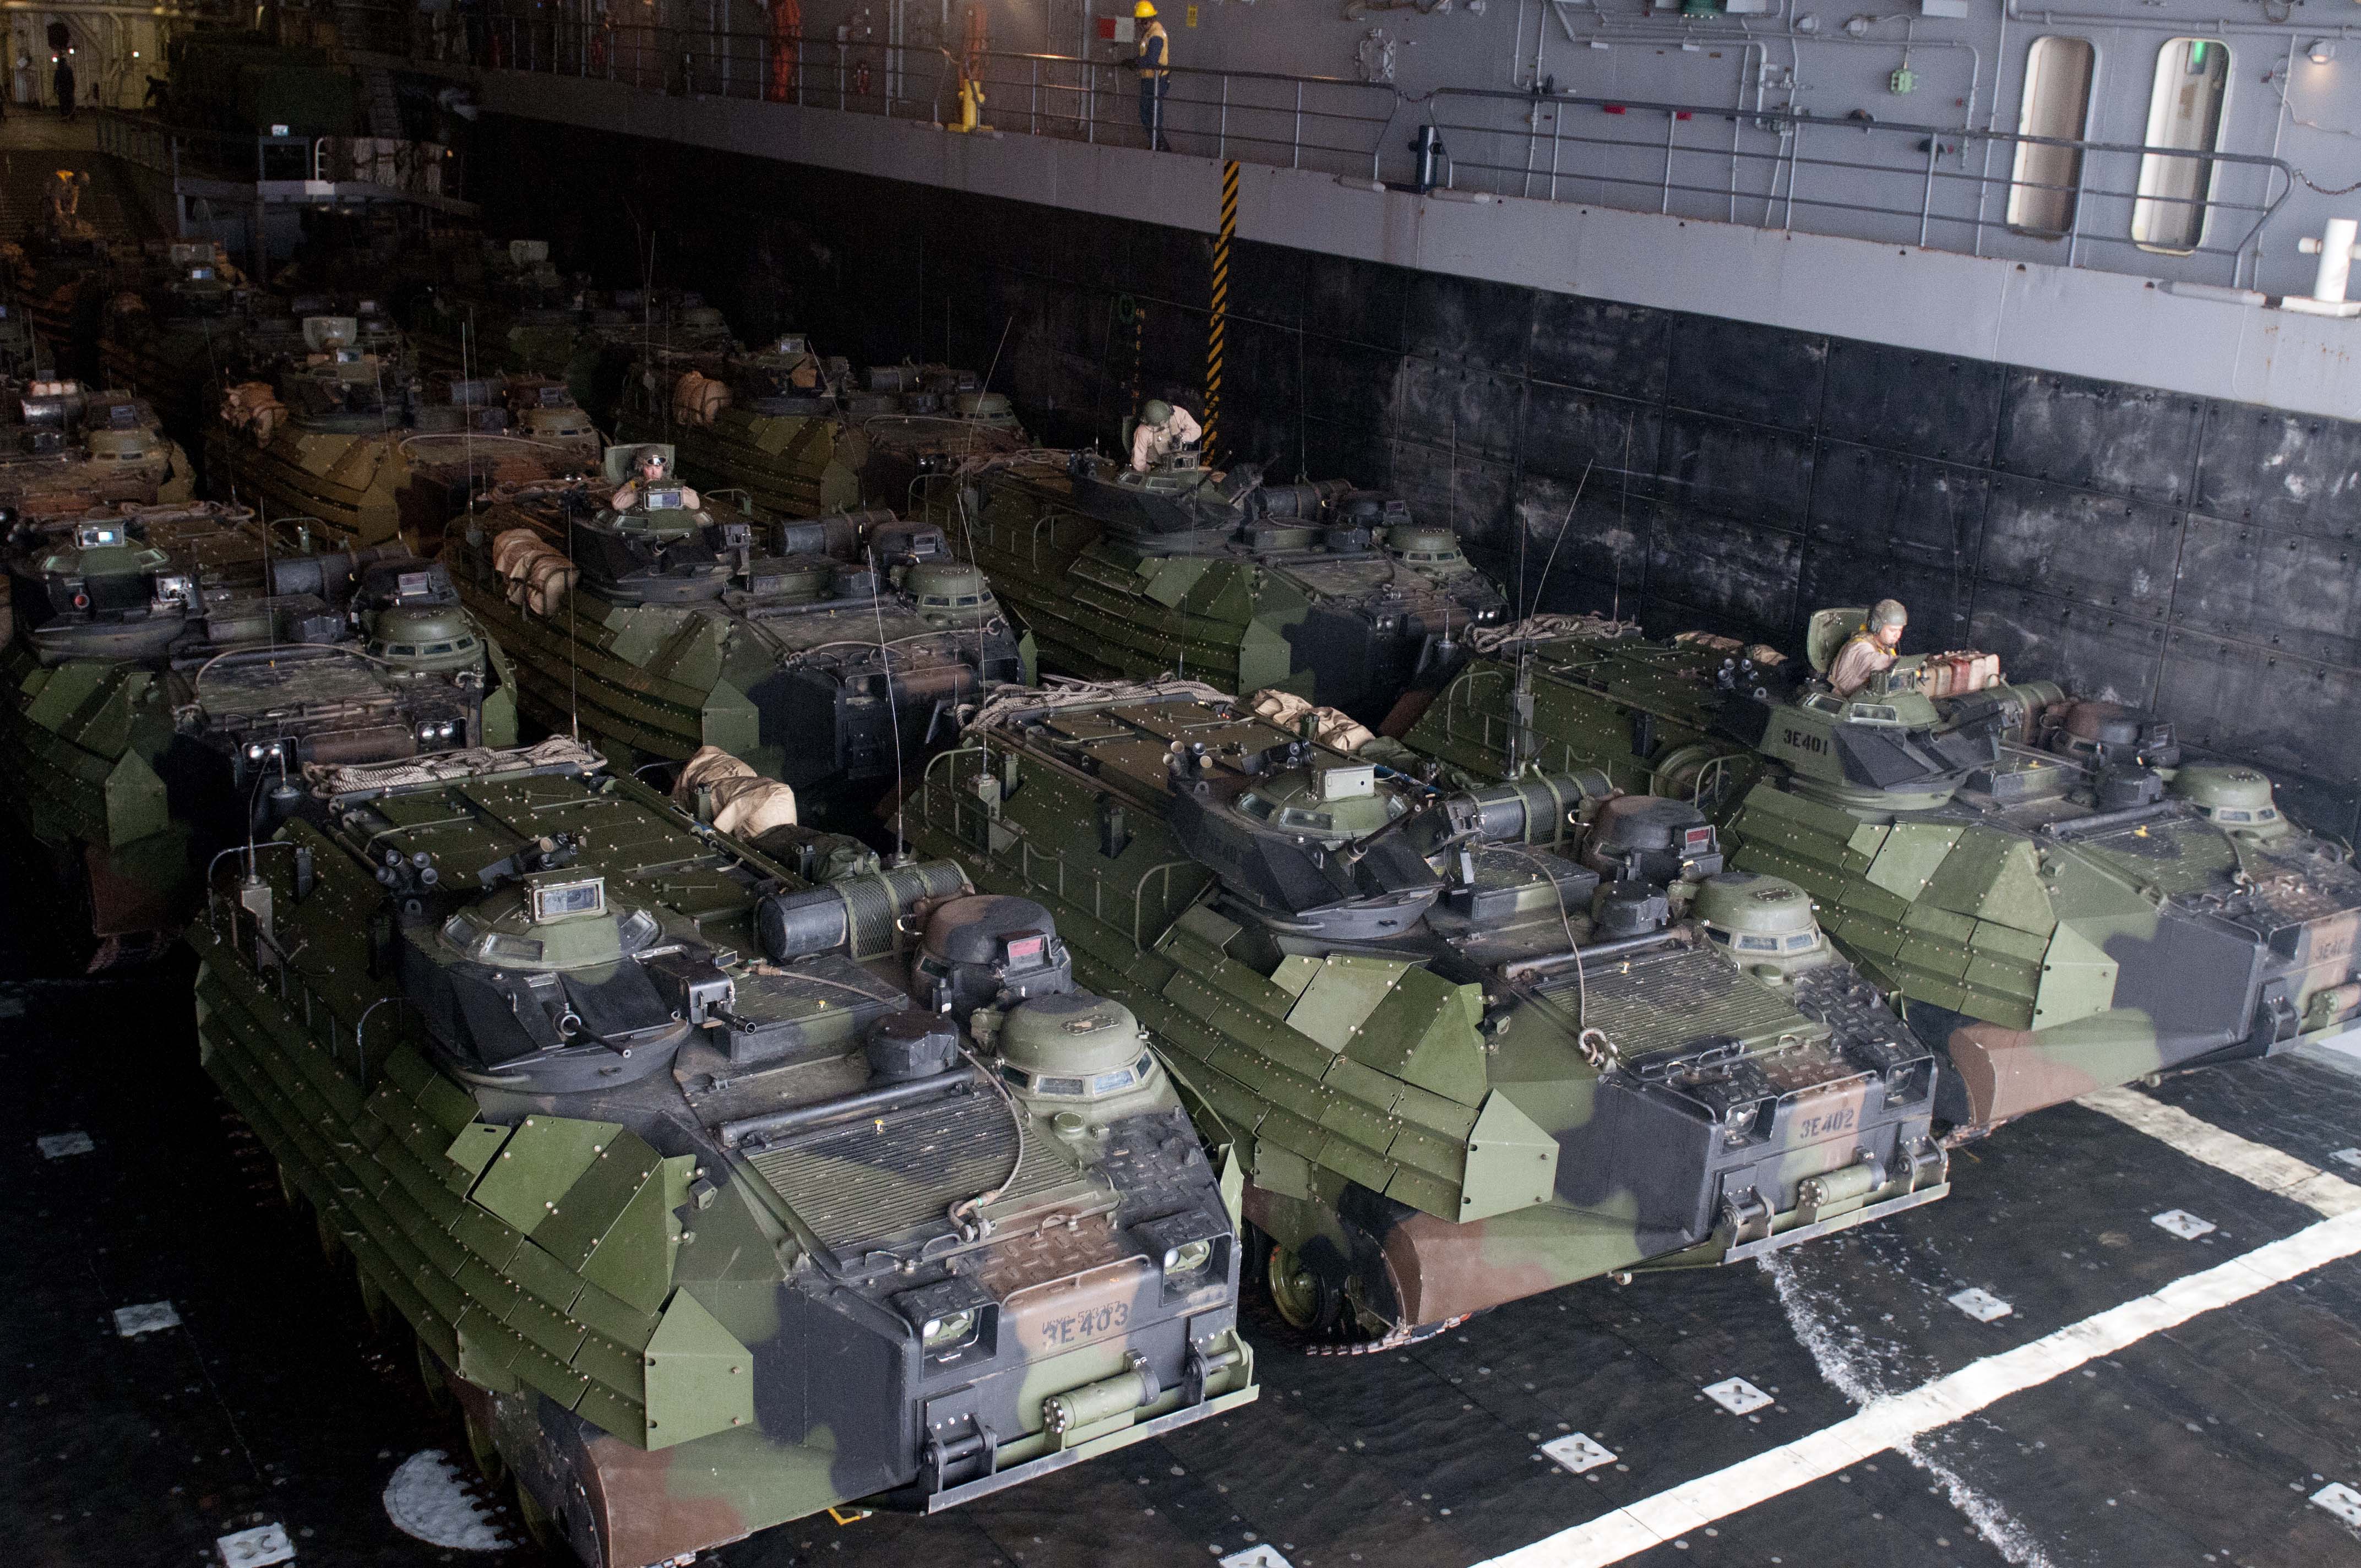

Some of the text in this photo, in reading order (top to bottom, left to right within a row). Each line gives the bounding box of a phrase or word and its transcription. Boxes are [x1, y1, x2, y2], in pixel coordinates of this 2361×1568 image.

[1783, 728, 1828, 755] 3E401
[2315, 938, 2352, 960] 3E40
[1800, 1108, 1854, 1139] 3E402
[1042, 1303, 1129, 1346] 3E403
